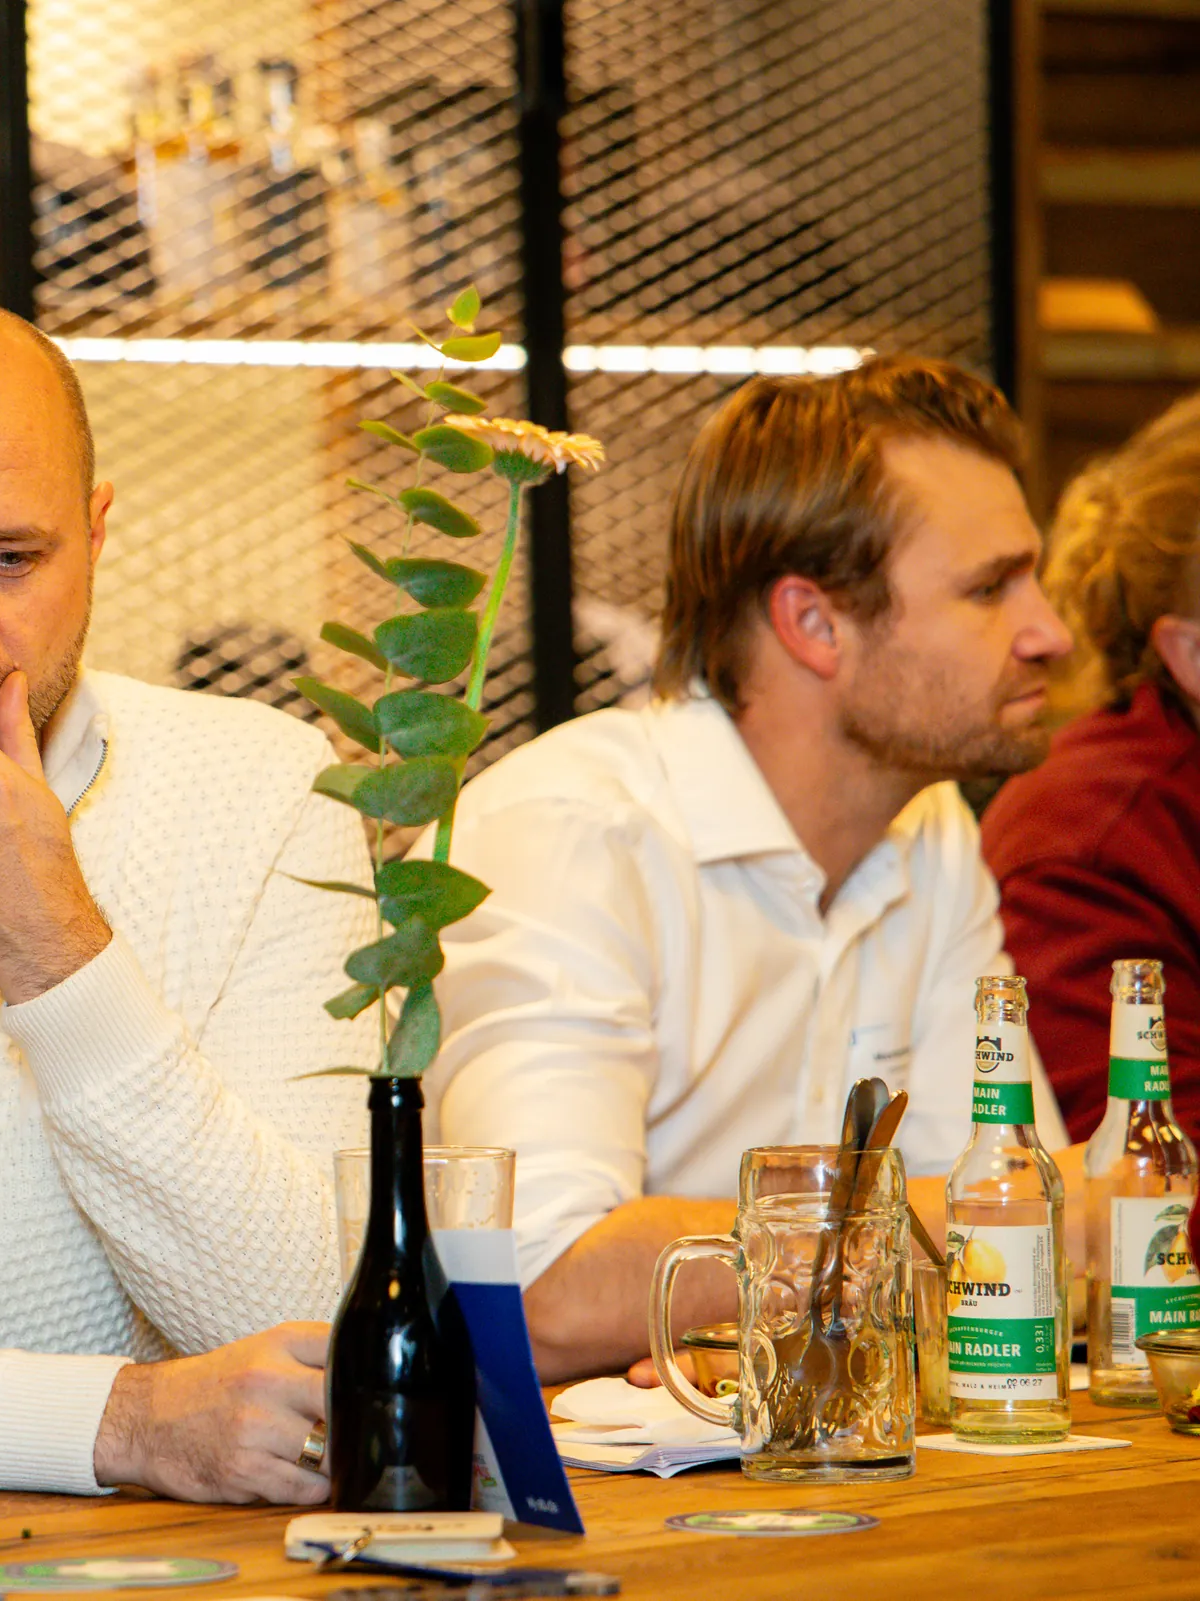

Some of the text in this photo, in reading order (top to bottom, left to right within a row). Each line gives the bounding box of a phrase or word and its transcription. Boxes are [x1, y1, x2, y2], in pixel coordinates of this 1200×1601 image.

[972, 1103, 1007, 1116] ADLER
[947, 1280, 1011, 1297] CHWIND
[1149, 1310, 1186, 1324] MAIN
[964, 1342, 1022, 1358] RADLER
